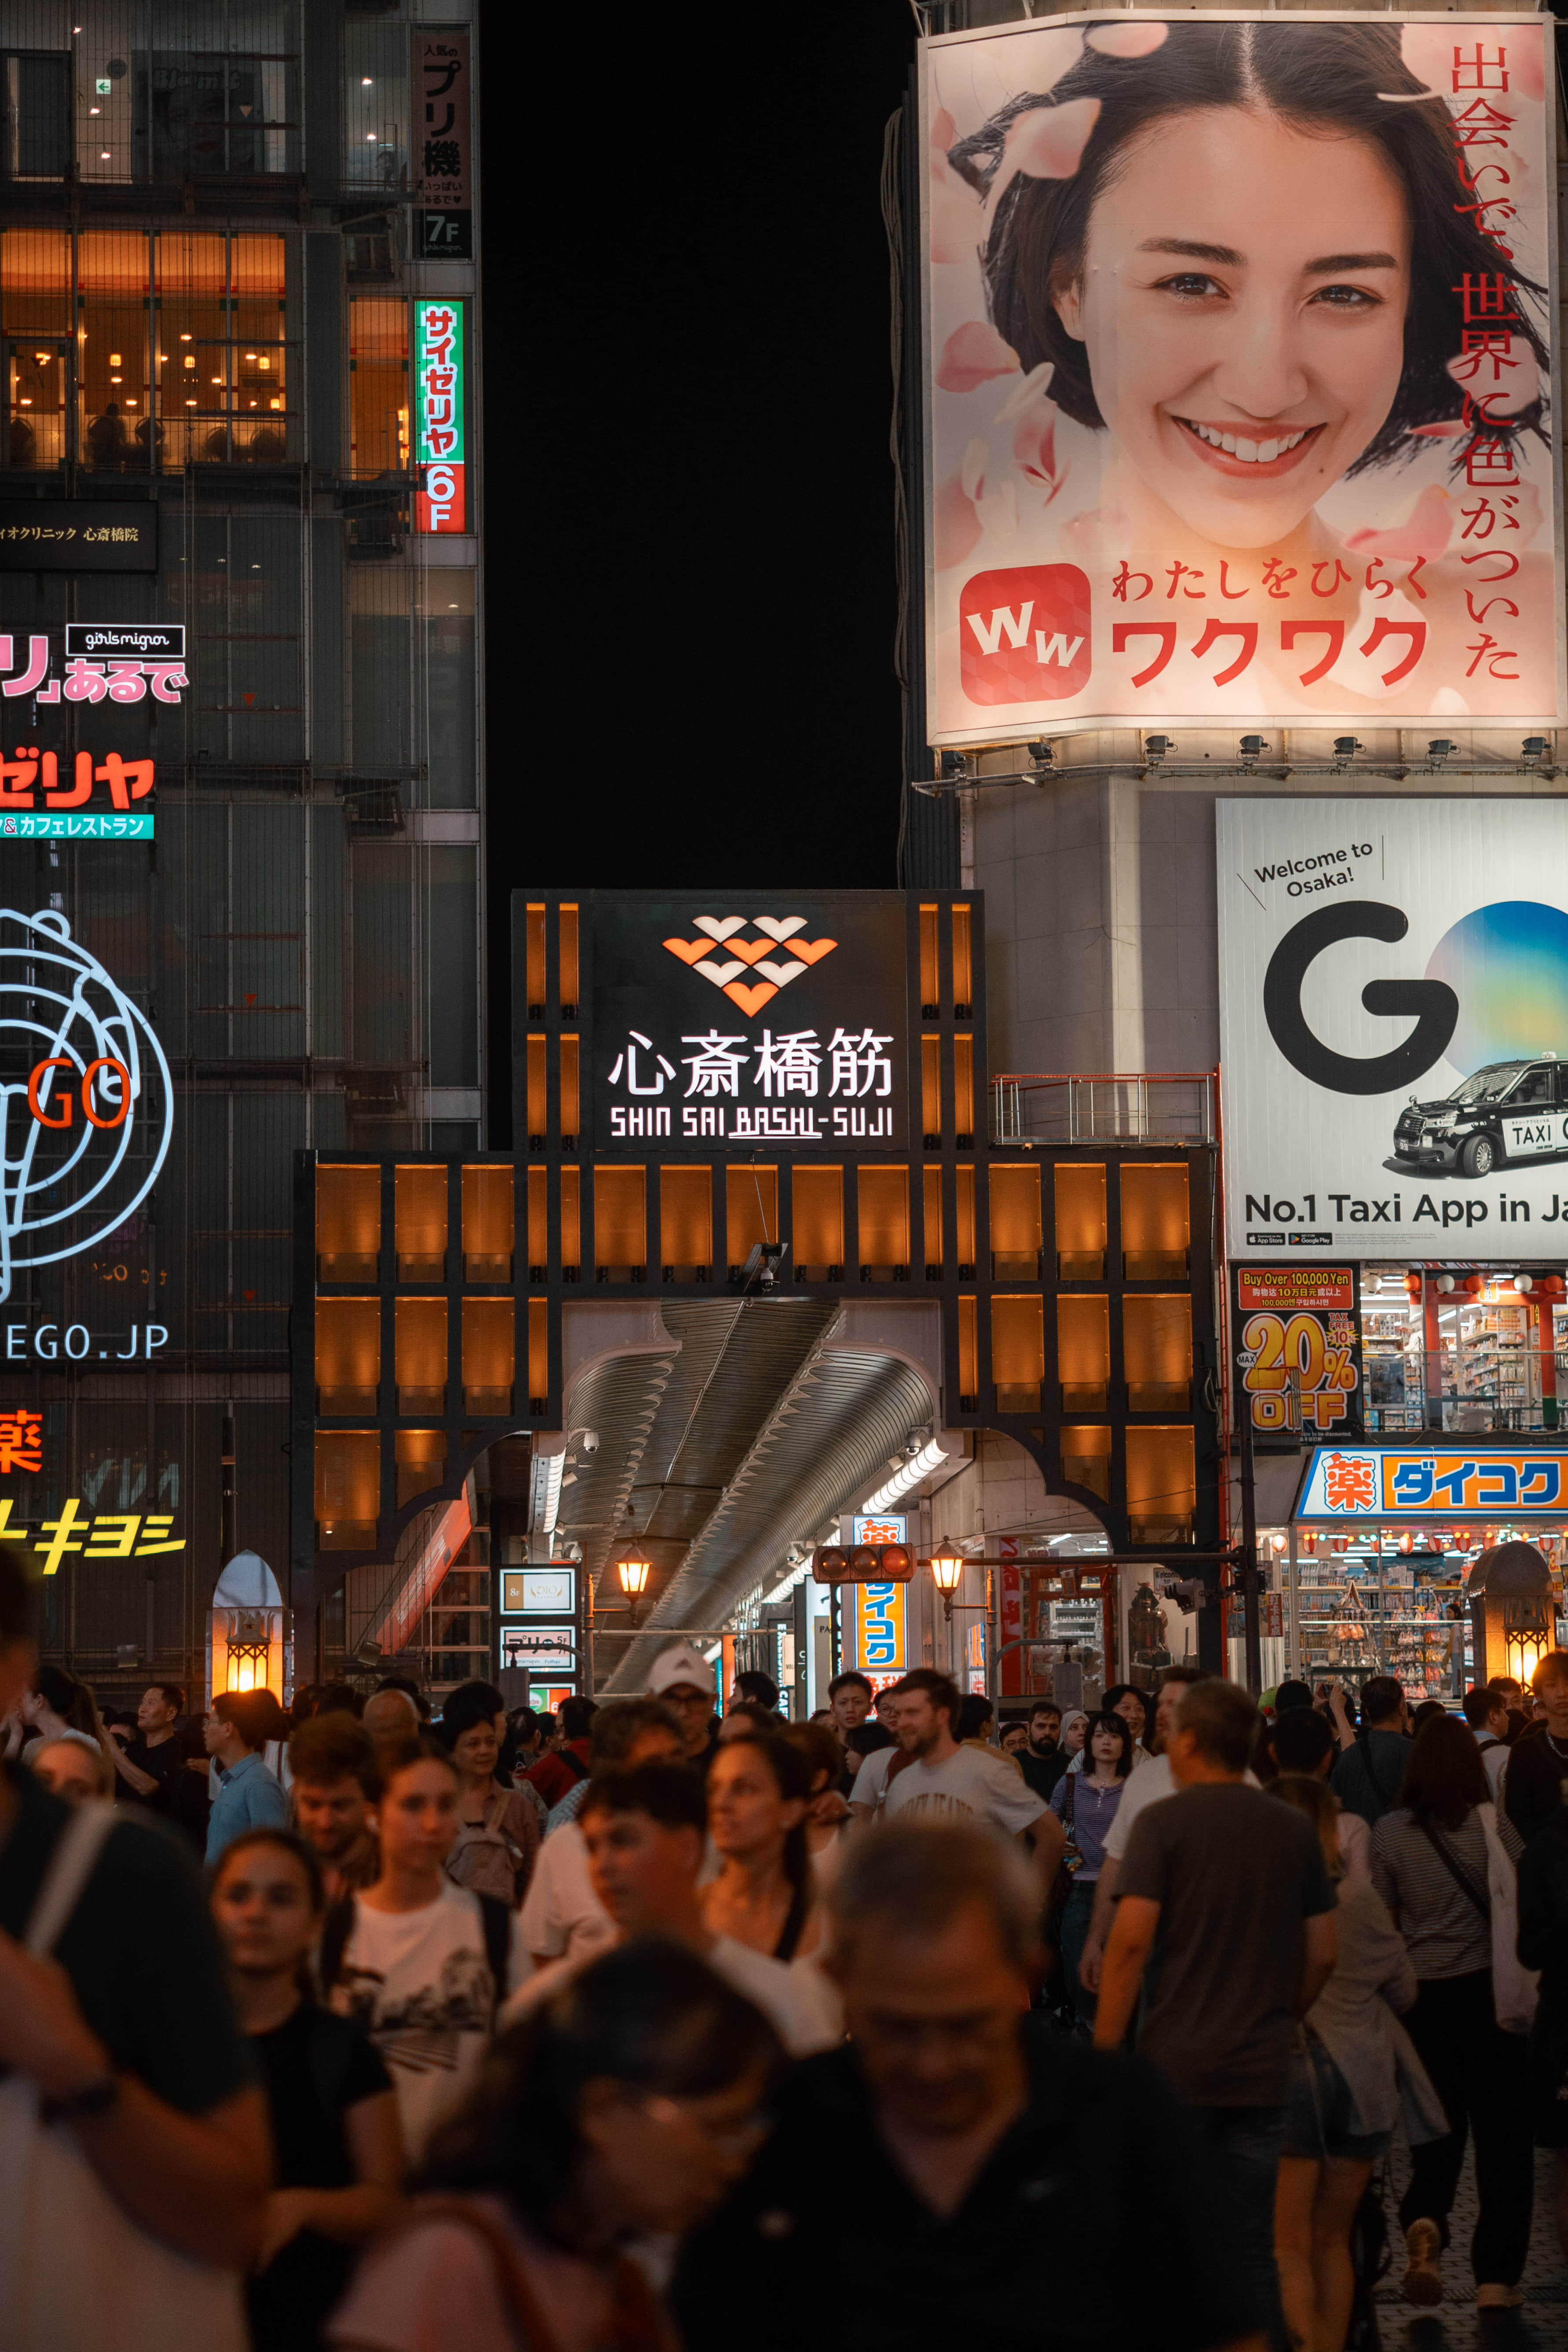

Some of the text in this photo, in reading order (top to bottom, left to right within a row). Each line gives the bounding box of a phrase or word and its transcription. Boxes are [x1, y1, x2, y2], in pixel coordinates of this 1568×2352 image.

[424, 45, 458, 57] 人気の
[424, 60, 461, 177] プリ機
[426, 216, 459, 242] 7F
[1446, 43, 1523, 680] 出会いで、世界に色がついた
[423, 308, 456, 456] サイゼリヤ
[427, 465, 455, 531] 6F
[83, 527, 139, 542] 心斎橋院
[1112, 555, 1427, 602] わたしをひらく
[1112, 617, 1427, 688] ワクワク
[1254, 842, 1373, 884] Welcome to
[1287, 867, 1355, 898] Osaka!
[607, 1027, 895, 1098] 心斎橋筋
[611, 1107, 671, 1136] SHIN
[683, 1107, 725, 1136] SAI
[1512, 1124, 1551, 1145] TAXI
[1246, 1194, 1316, 1223] No.1
[1328, 1193, 1401, 1222] Taxi
[1412, 1194, 1488, 1228] App
[1500, 1193, 1530, 1222] in
[1243, 1273, 1349, 1287] Buy Over 100,000 Yen
[7, 1324, 169, 1360] EGO.JP
[1244, 1314, 1356, 1391] 20%
[1329, 1331, 1355, 1344] +10%
[1326, 1453, 1560, 1511] 薬 ダイコク
[510, 1588, 520, 1597] 8F
